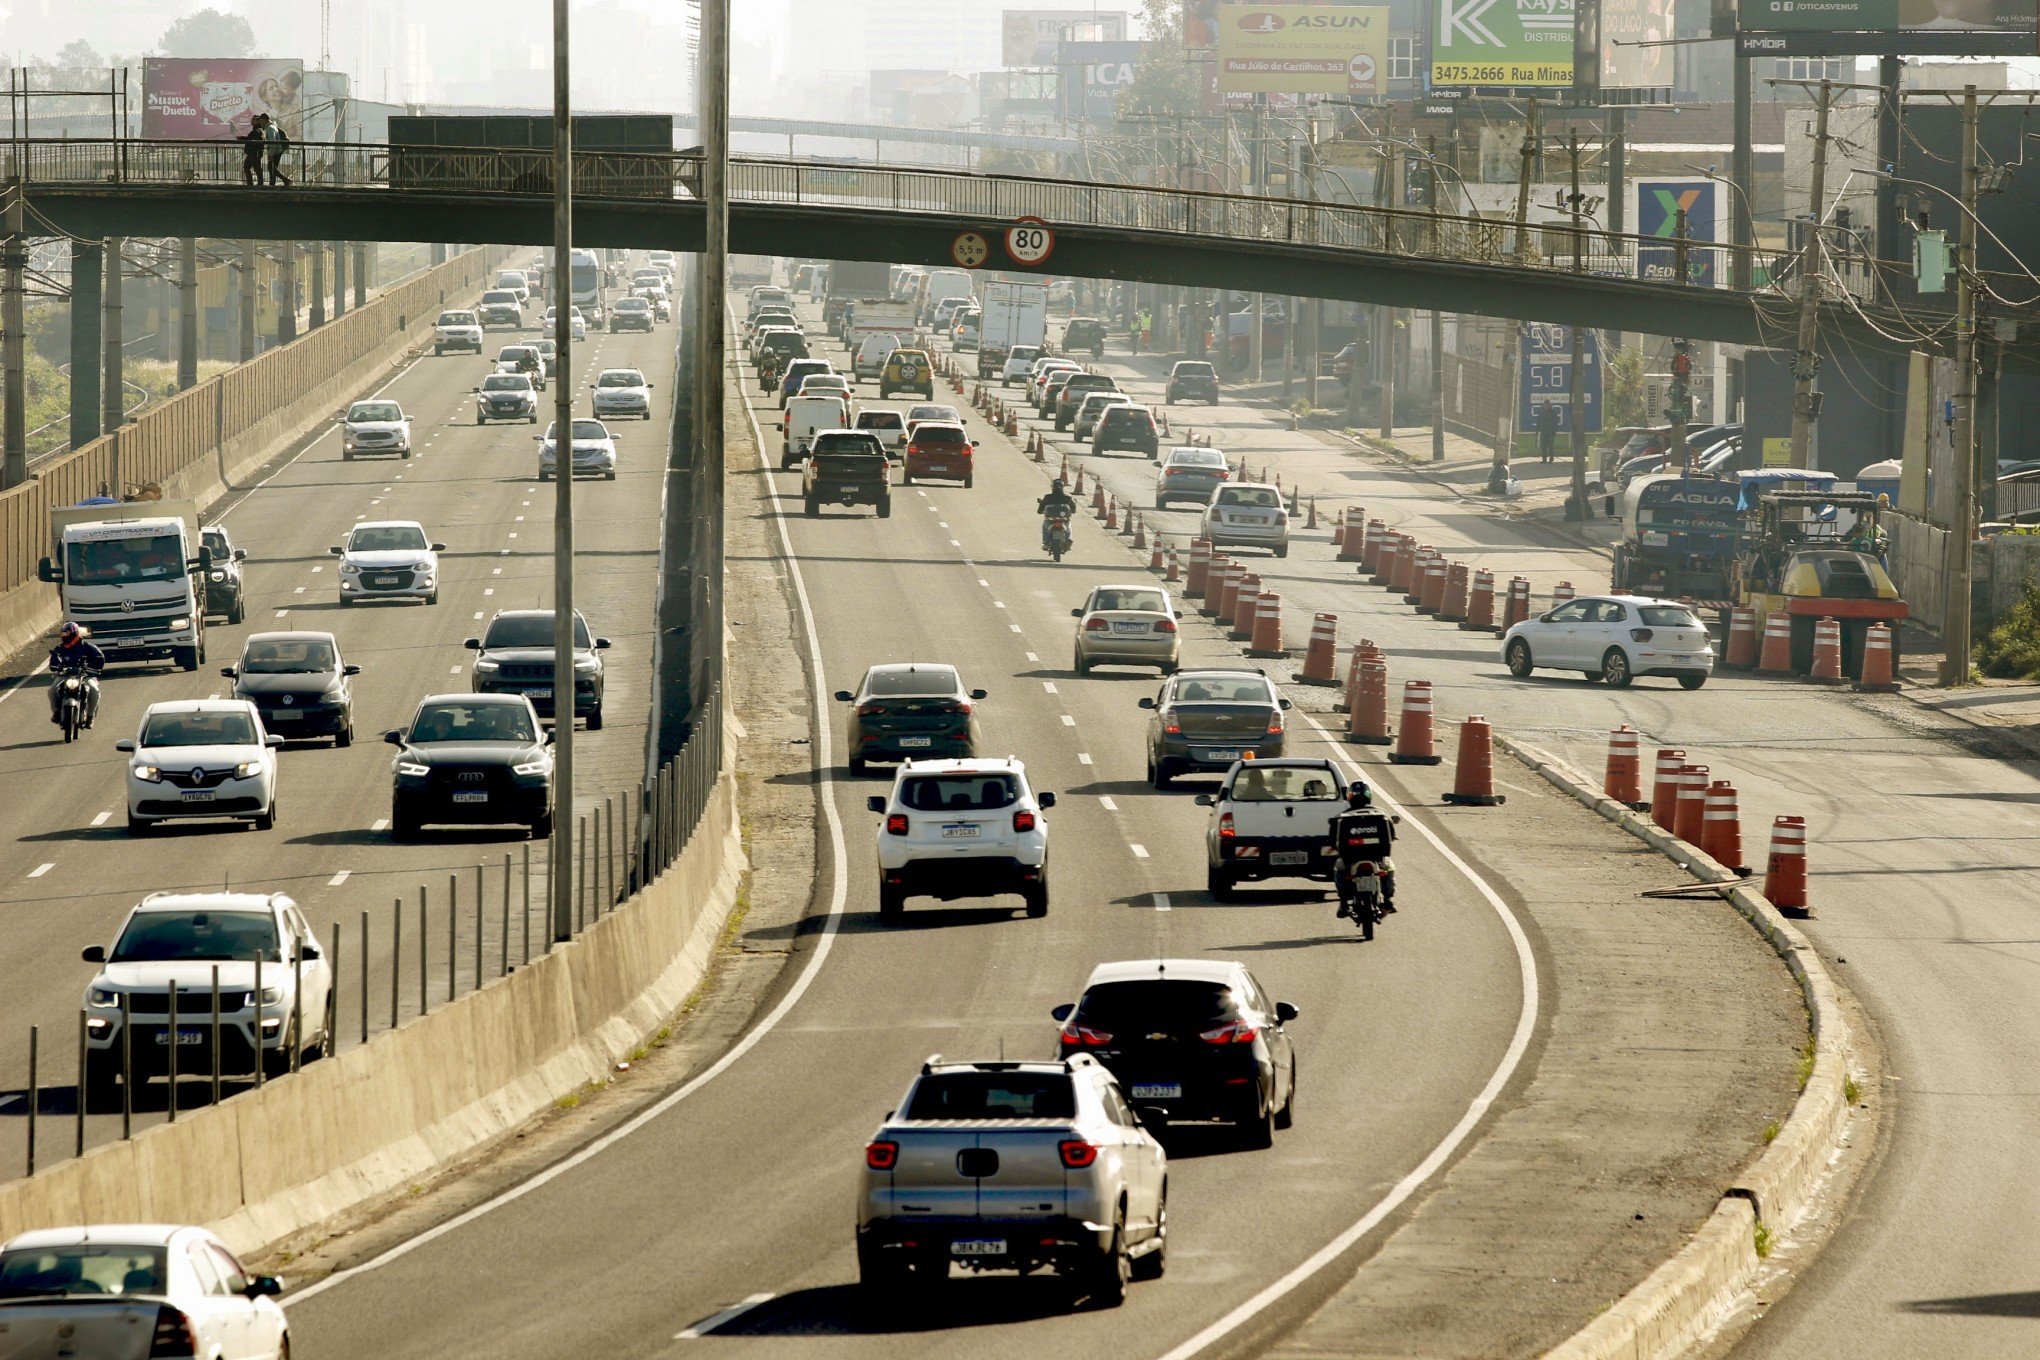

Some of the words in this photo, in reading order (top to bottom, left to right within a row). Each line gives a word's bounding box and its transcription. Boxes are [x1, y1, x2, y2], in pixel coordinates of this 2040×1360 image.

[1292, 15, 1371, 28] ASUN
[1229, 62, 1247, 70] Rua
[1247, 61, 1269, 71] Júlio
[1271, 62, 1282, 71] de
[1283, 62, 1325, 72] Castilhos,
[1327, 62, 1344, 71] 263
[1435, 67, 1505, 81] 3475.2666
[1511, 68, 1534, 81] Rua
[1537, 68, 1574, 81] Minas
[148, 93, 190, 106] Suave
[210, 96, 242, 110] Duetto
[162, 106, 197, 116] Duetto
[1016, 230, 1043, 249] 80
[959, 245, 973, 255] 5,5
[1531, 366, 1563, 387] 5.8
[1670, 492, 1735, 506] ÁGUA
